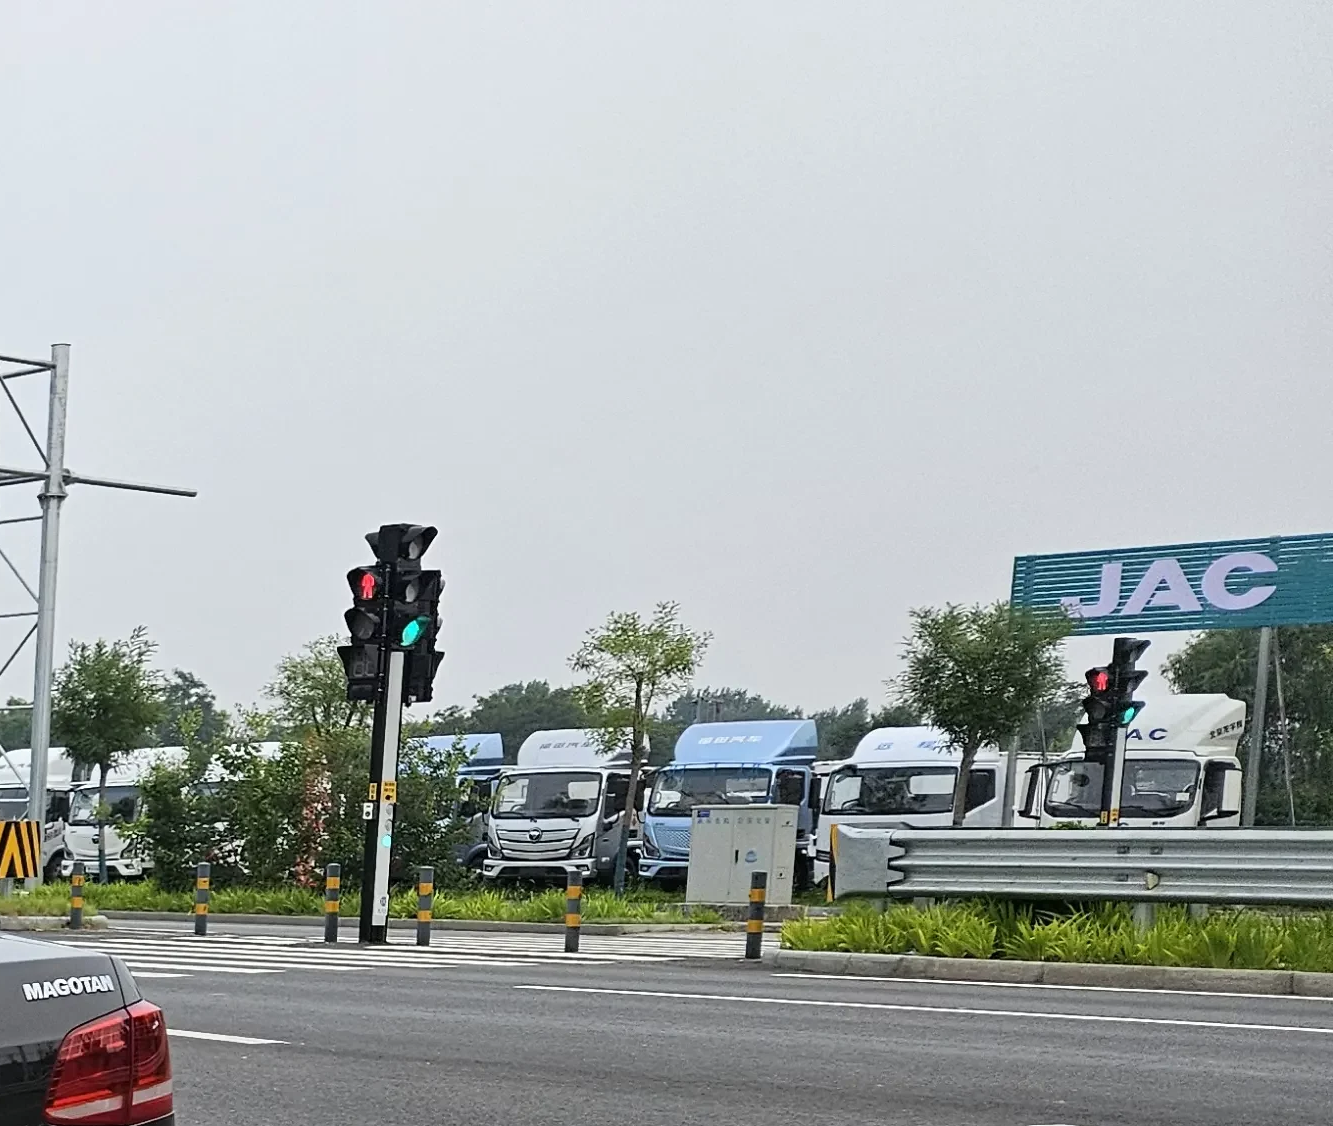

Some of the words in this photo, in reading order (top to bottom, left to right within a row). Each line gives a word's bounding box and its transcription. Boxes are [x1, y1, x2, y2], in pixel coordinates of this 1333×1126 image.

[1060, 551, 1278, 618] JAC
[1126, 728, 1168, 741] AC
[22, 974, 115, 1001] MAGOTAN
